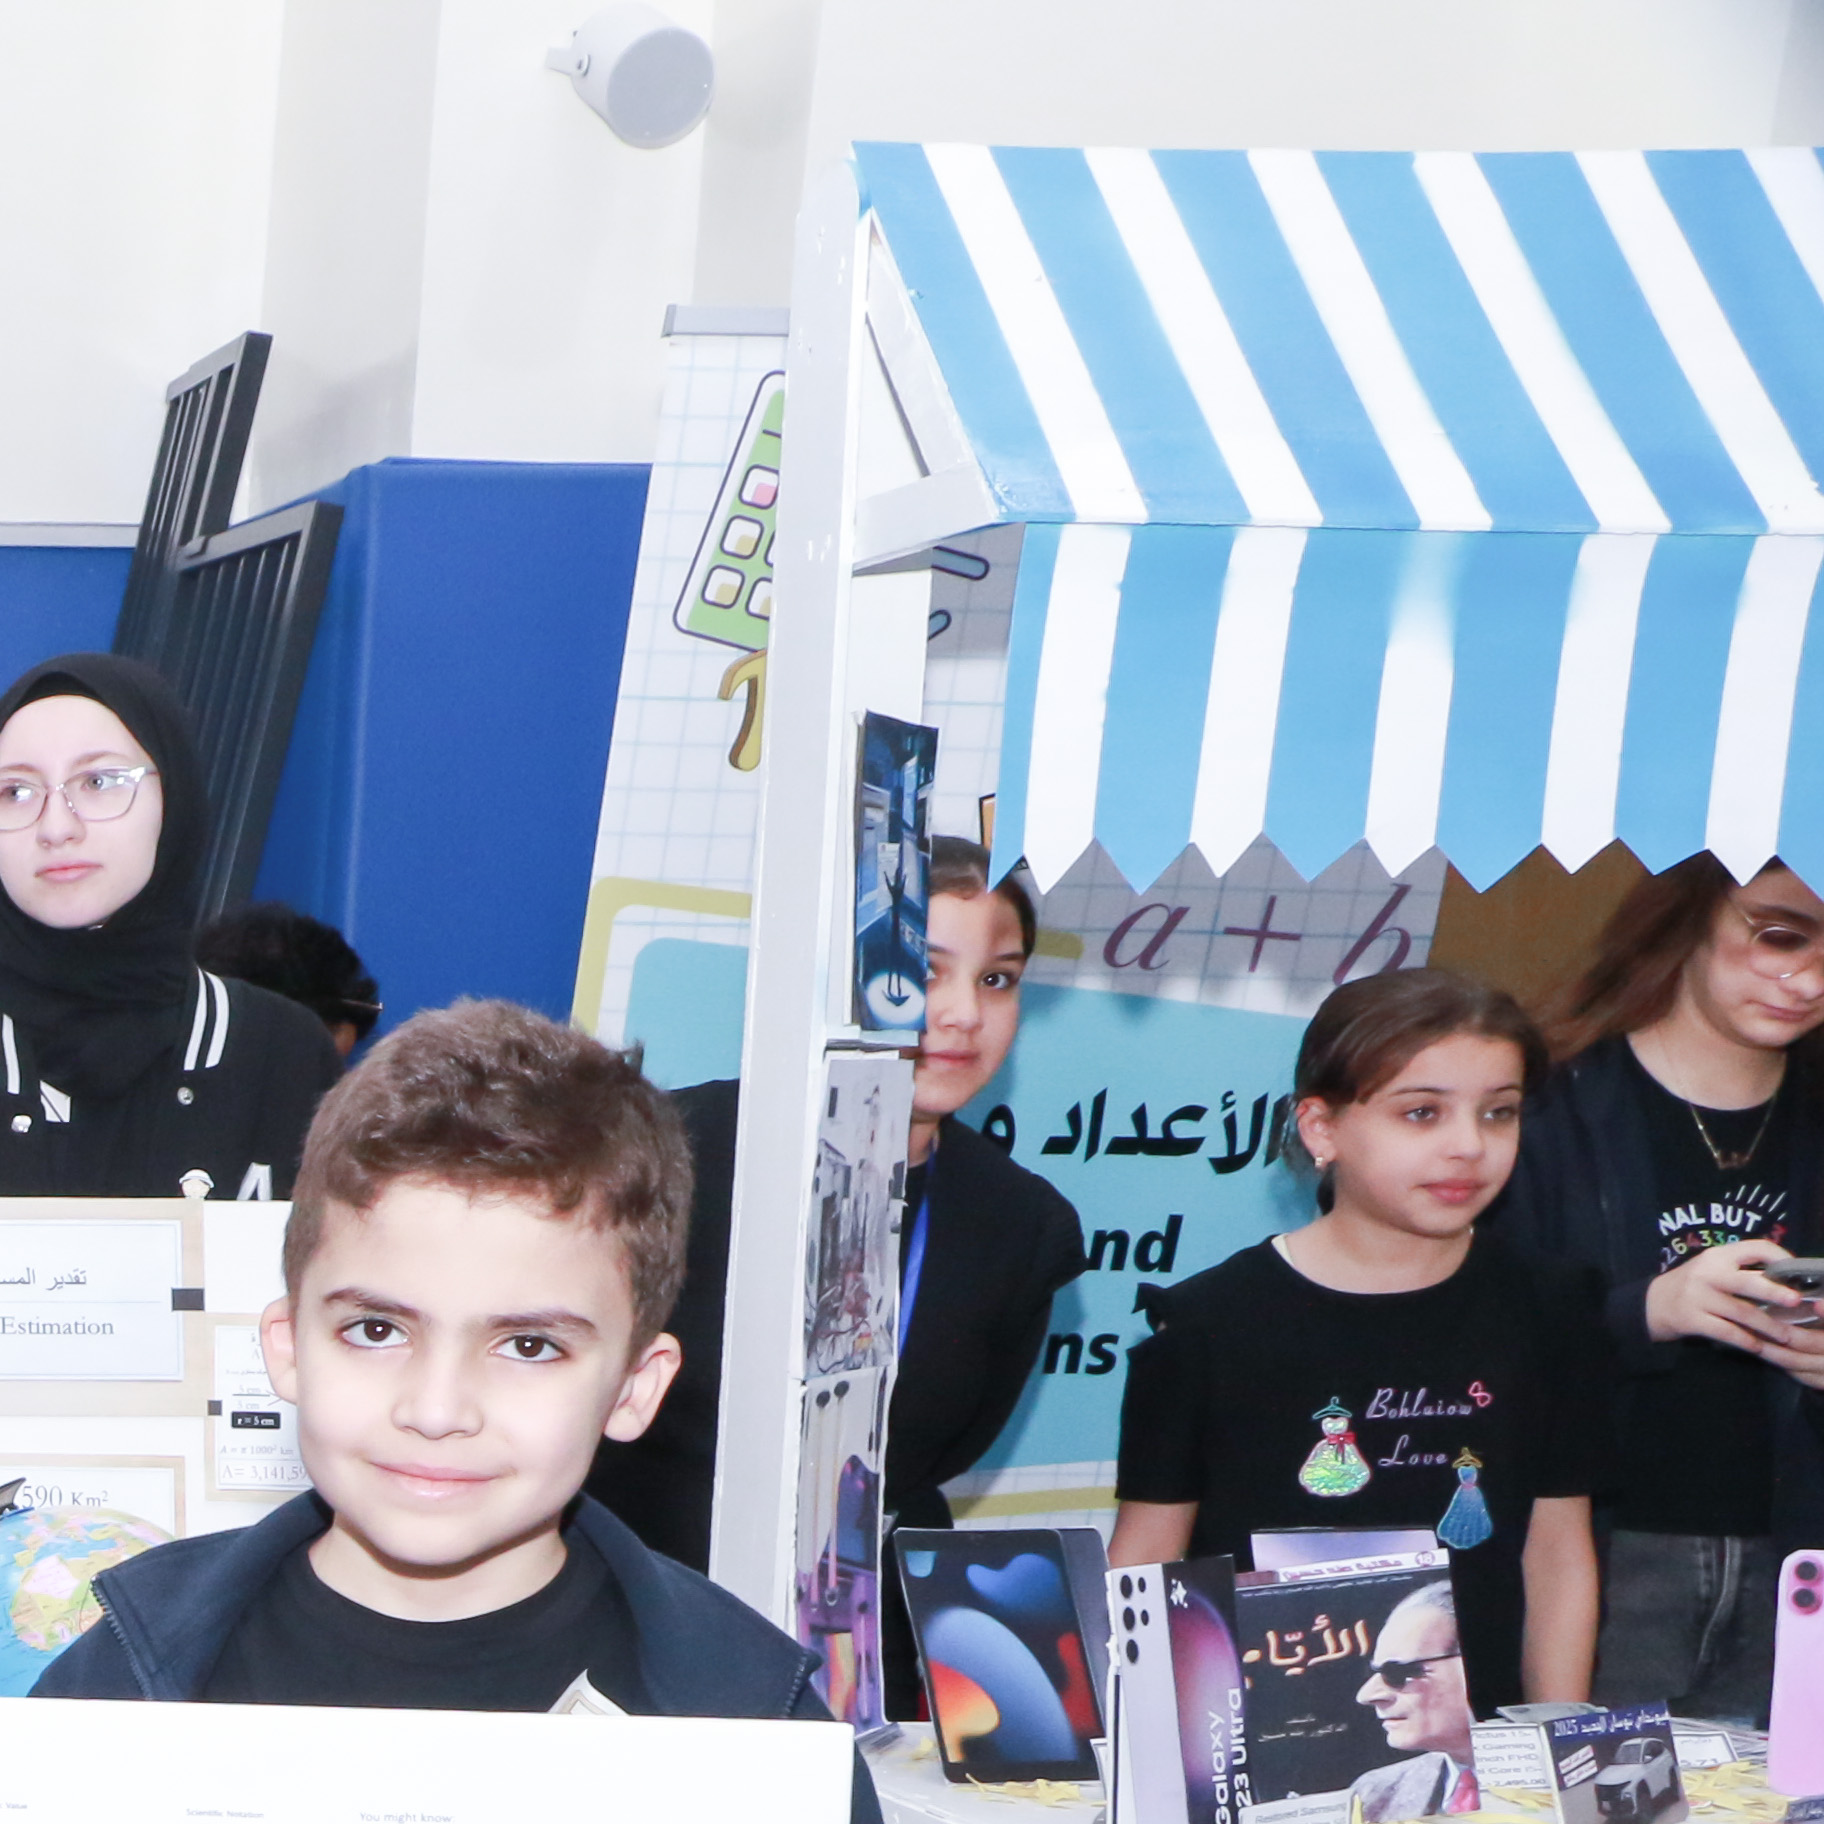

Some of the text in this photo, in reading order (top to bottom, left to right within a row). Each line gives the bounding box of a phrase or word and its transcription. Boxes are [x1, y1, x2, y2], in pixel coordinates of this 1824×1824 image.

[1103, 902, 1190, 972] a
[1658, 1202, 1762, 1236] NAL BUT
[1087, 1213, 1184, 1273] nd
[46, 1269, 87, 1291] تقدير
[0, 1315, 115, 1336] Estimation
[1042, 1331, 1120, 1375] ns
[1378, 1434, 1448, 1466] Love
[1553, 1718, 1578, 1737] 2025
[1228, 1688, 1253, 1808] 23 Ultra
